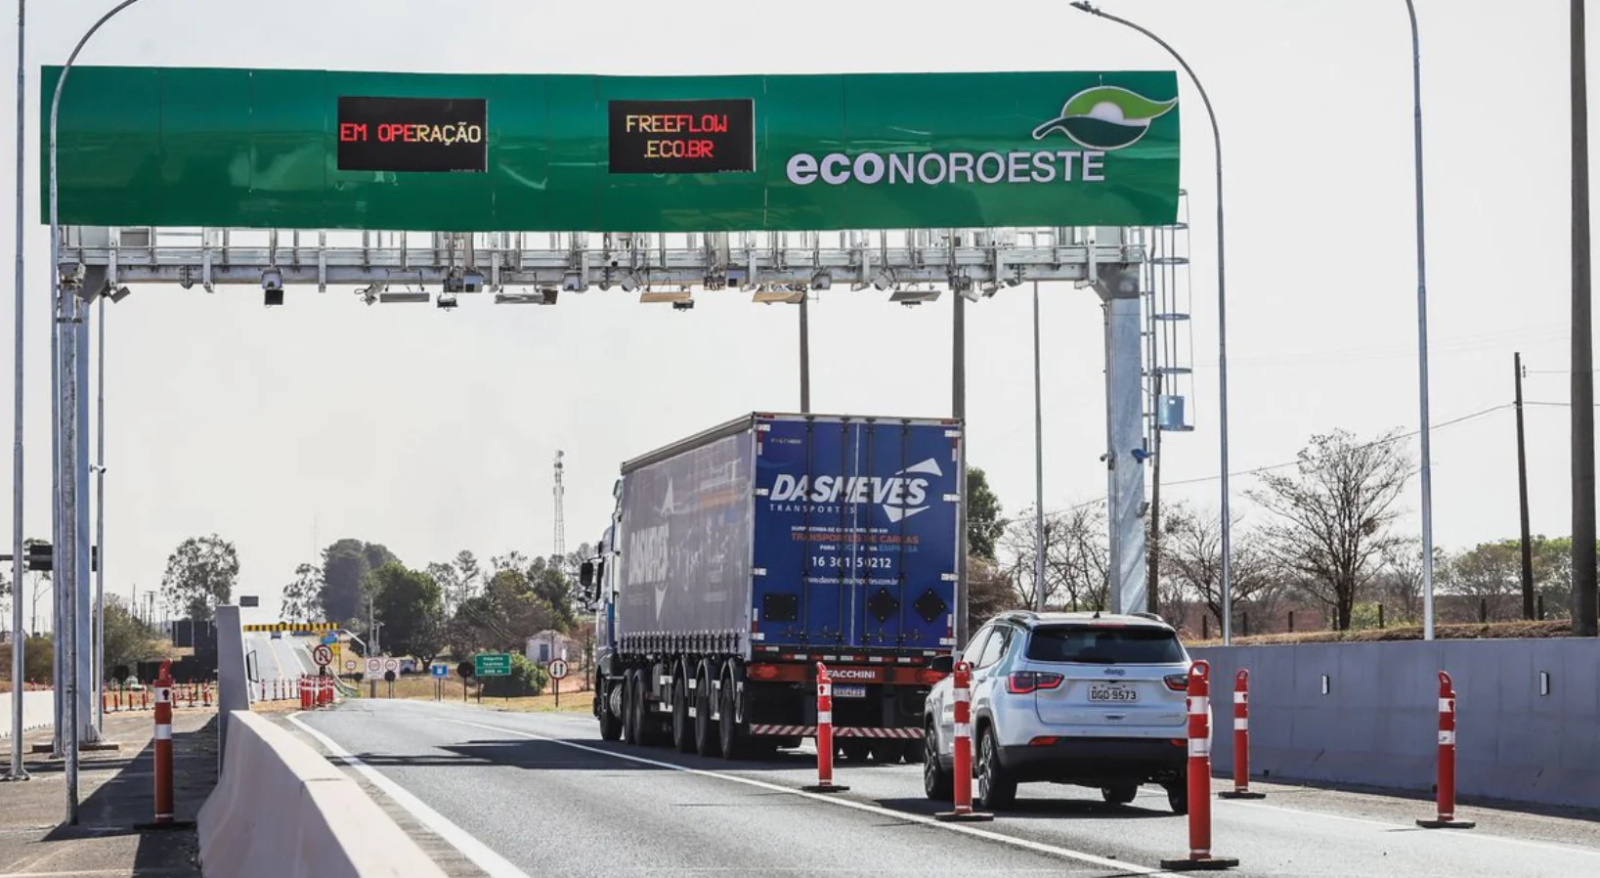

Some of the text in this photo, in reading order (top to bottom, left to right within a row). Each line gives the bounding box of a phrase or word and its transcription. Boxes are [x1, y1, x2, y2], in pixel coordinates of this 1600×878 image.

[625, 115, 728, 132] FREEFLOW
[340, 121, 482, 146] EM OPERAÇÃO
[643, 140, 714, 158] .ECO.BR
[770, 474, 929, 506] DASNEVES
[880, 534, 919, 545] CARAS
[812, 556, 825, 567] 16
[826, 670, 875, 679] FACCHINI
